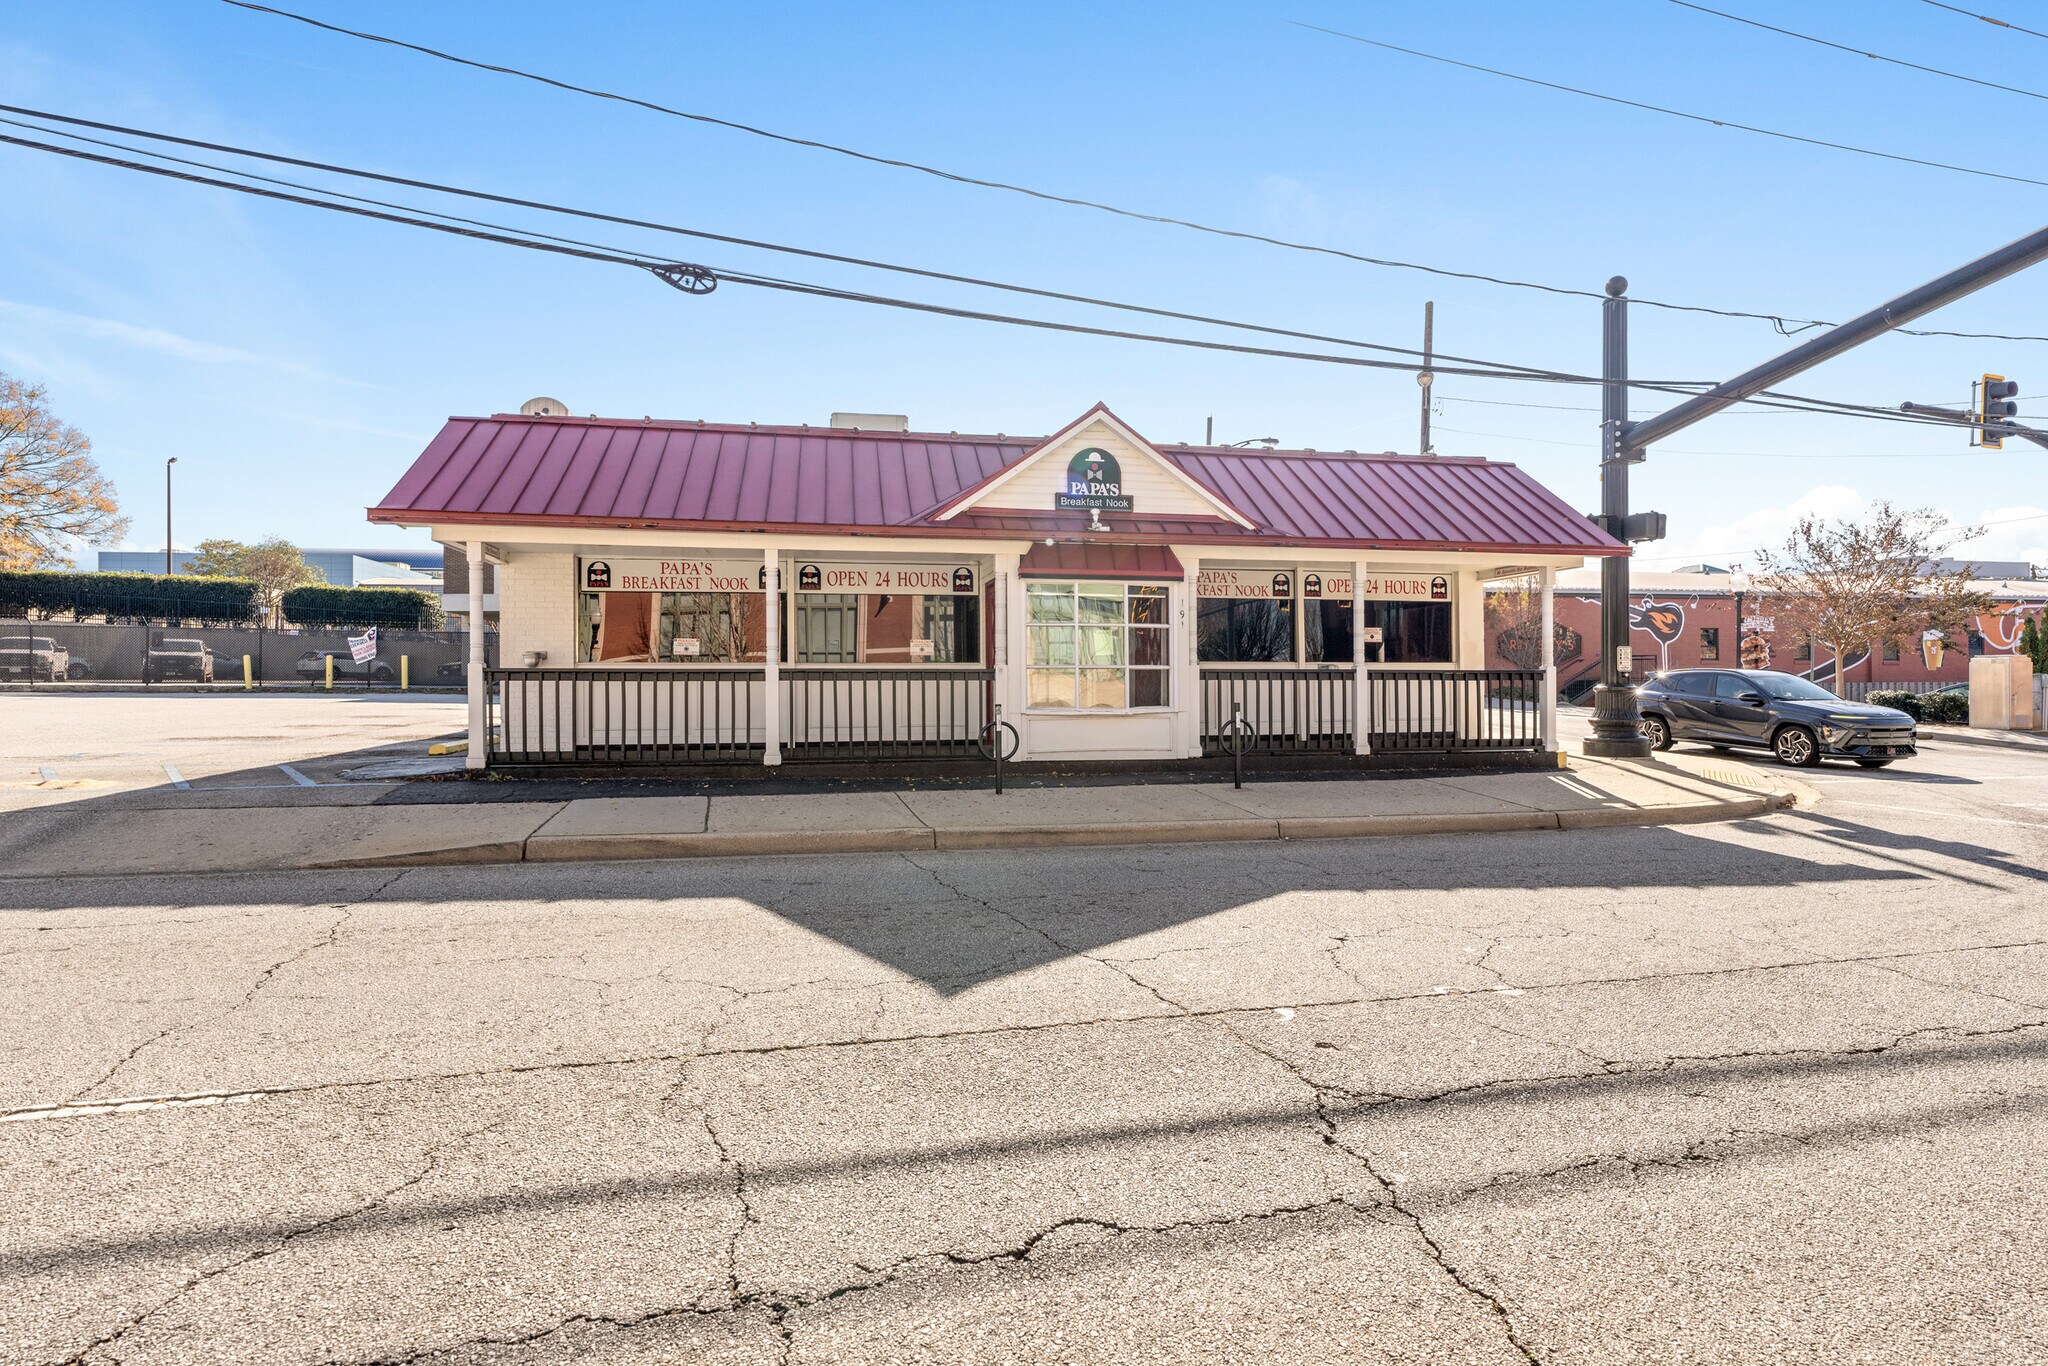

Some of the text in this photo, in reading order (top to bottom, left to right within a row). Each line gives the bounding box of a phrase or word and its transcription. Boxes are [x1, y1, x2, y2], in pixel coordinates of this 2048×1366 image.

[1070, 481, 1120, 496] PAPA'S
[1060, 497, 1129, 508] Breakfast Nook
[660, 562, 713, 576] PAPA'S
[622, 576, 702, 590] BREAKFAST
[710, 577, 749, 590] NOOK
[827, 570, 949, 588] OPEN 24 HOURS
[1197, 571, 1238, 583] PAPA'S
[1235, 585, 1269, 597] NOOK
[1327, 578, 1427, 594] OPE 24 HOURS
